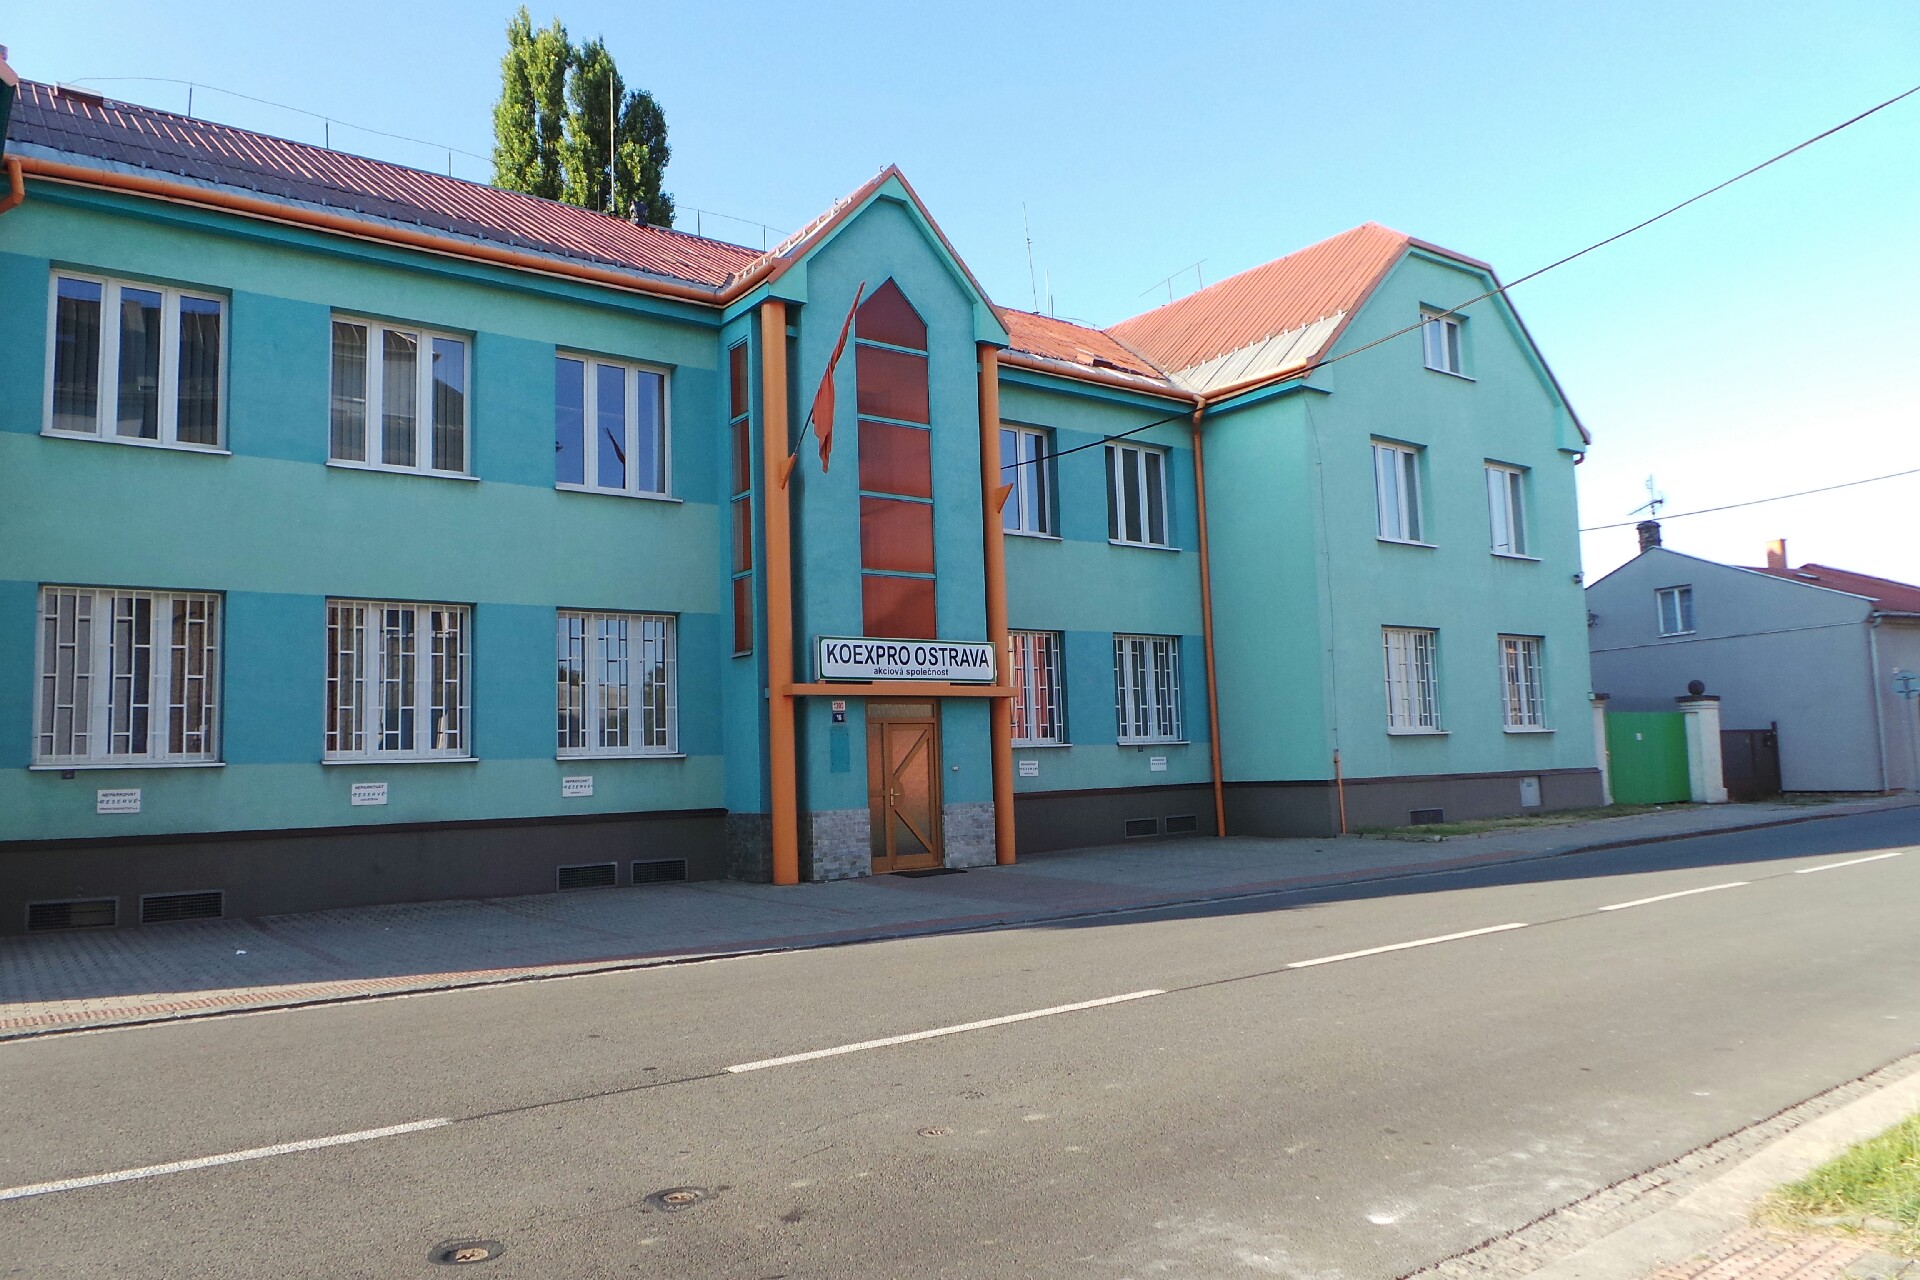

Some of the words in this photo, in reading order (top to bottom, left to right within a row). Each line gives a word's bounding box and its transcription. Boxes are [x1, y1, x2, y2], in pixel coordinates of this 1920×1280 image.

[826, 643, 911, 666] KOEXPRO
[914, 646, 990, 668] OSTRAVA
[873, 667, 904, 676] akciová
[905, 667, 949, 677] společnost
